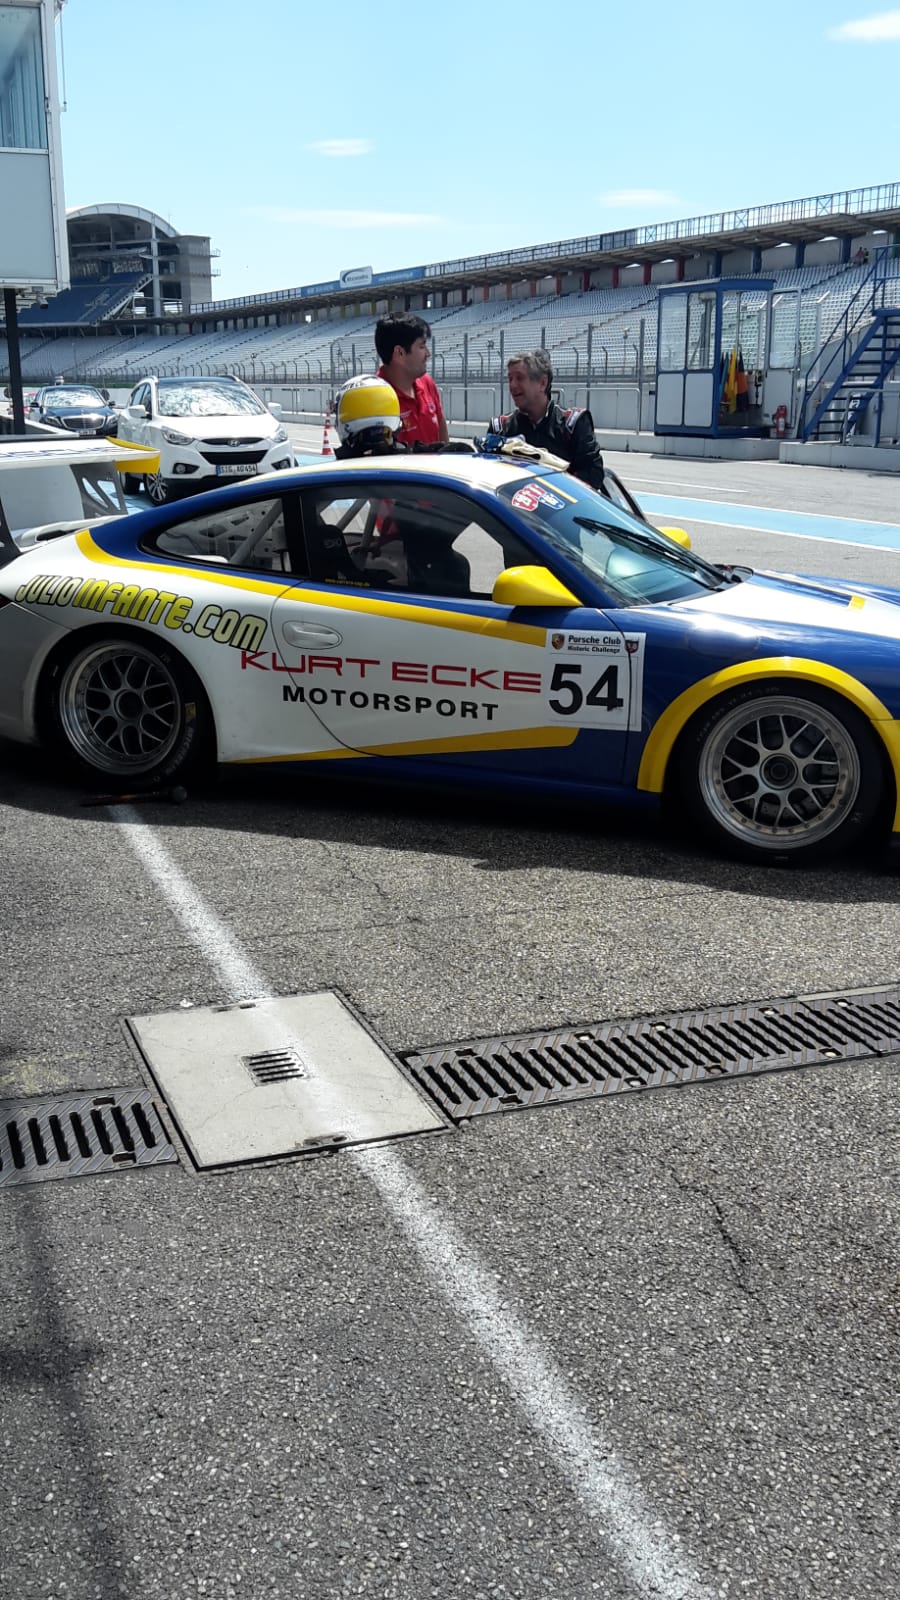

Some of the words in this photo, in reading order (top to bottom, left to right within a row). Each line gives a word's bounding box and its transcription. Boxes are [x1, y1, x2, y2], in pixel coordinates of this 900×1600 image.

[568, 635, 600, 644] Porsche
[602, 636, 621, 645] Club
[591, 646, 620, 654] Challenge
[241, 650, 381, 678] KURT
[391, 661, 542, 694] ECKE
[549, 663, 624, 715] 54
[282, 685, 499, 721] MOTORSPORT
